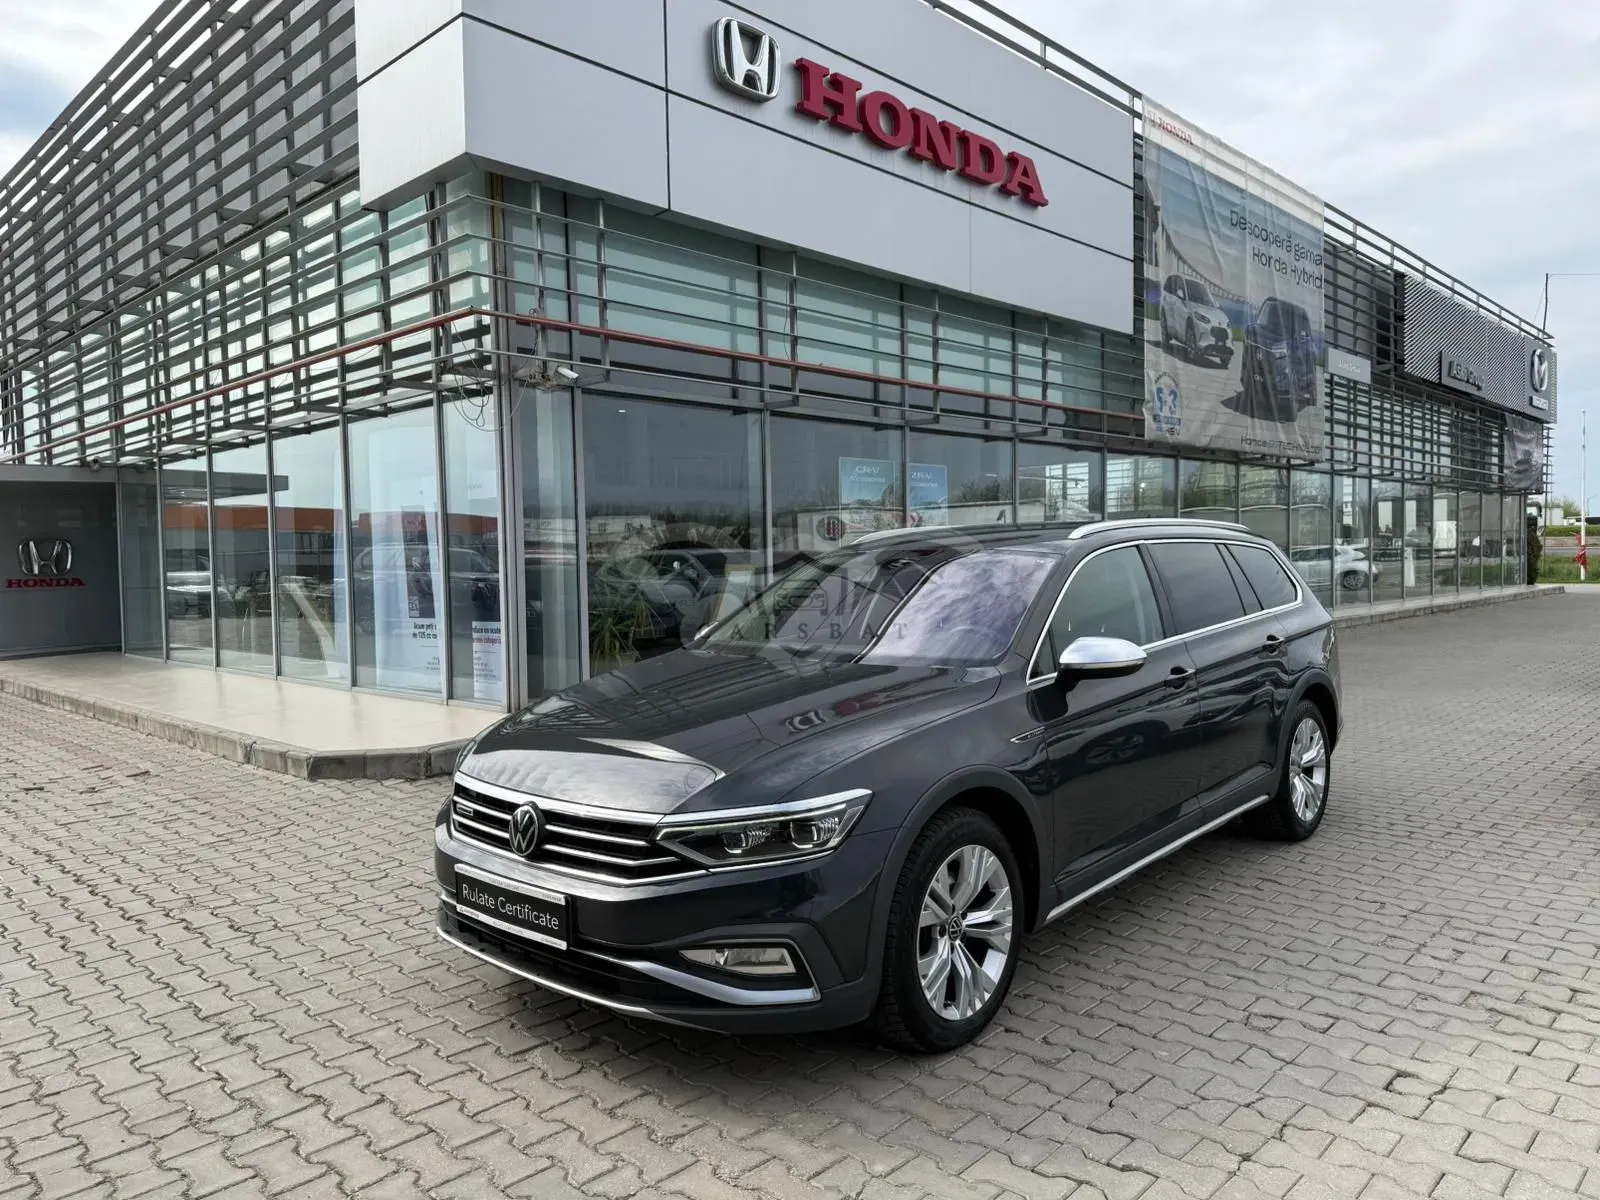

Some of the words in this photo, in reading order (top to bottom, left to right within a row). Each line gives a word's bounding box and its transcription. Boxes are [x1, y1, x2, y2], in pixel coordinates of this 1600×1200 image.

[794, 57, 1049, 208] HONDA
[7, 577, 86, 589] HONDA
[462, 884, 495, 909] Rulate
[497, 896, 559, 930] Certificate
